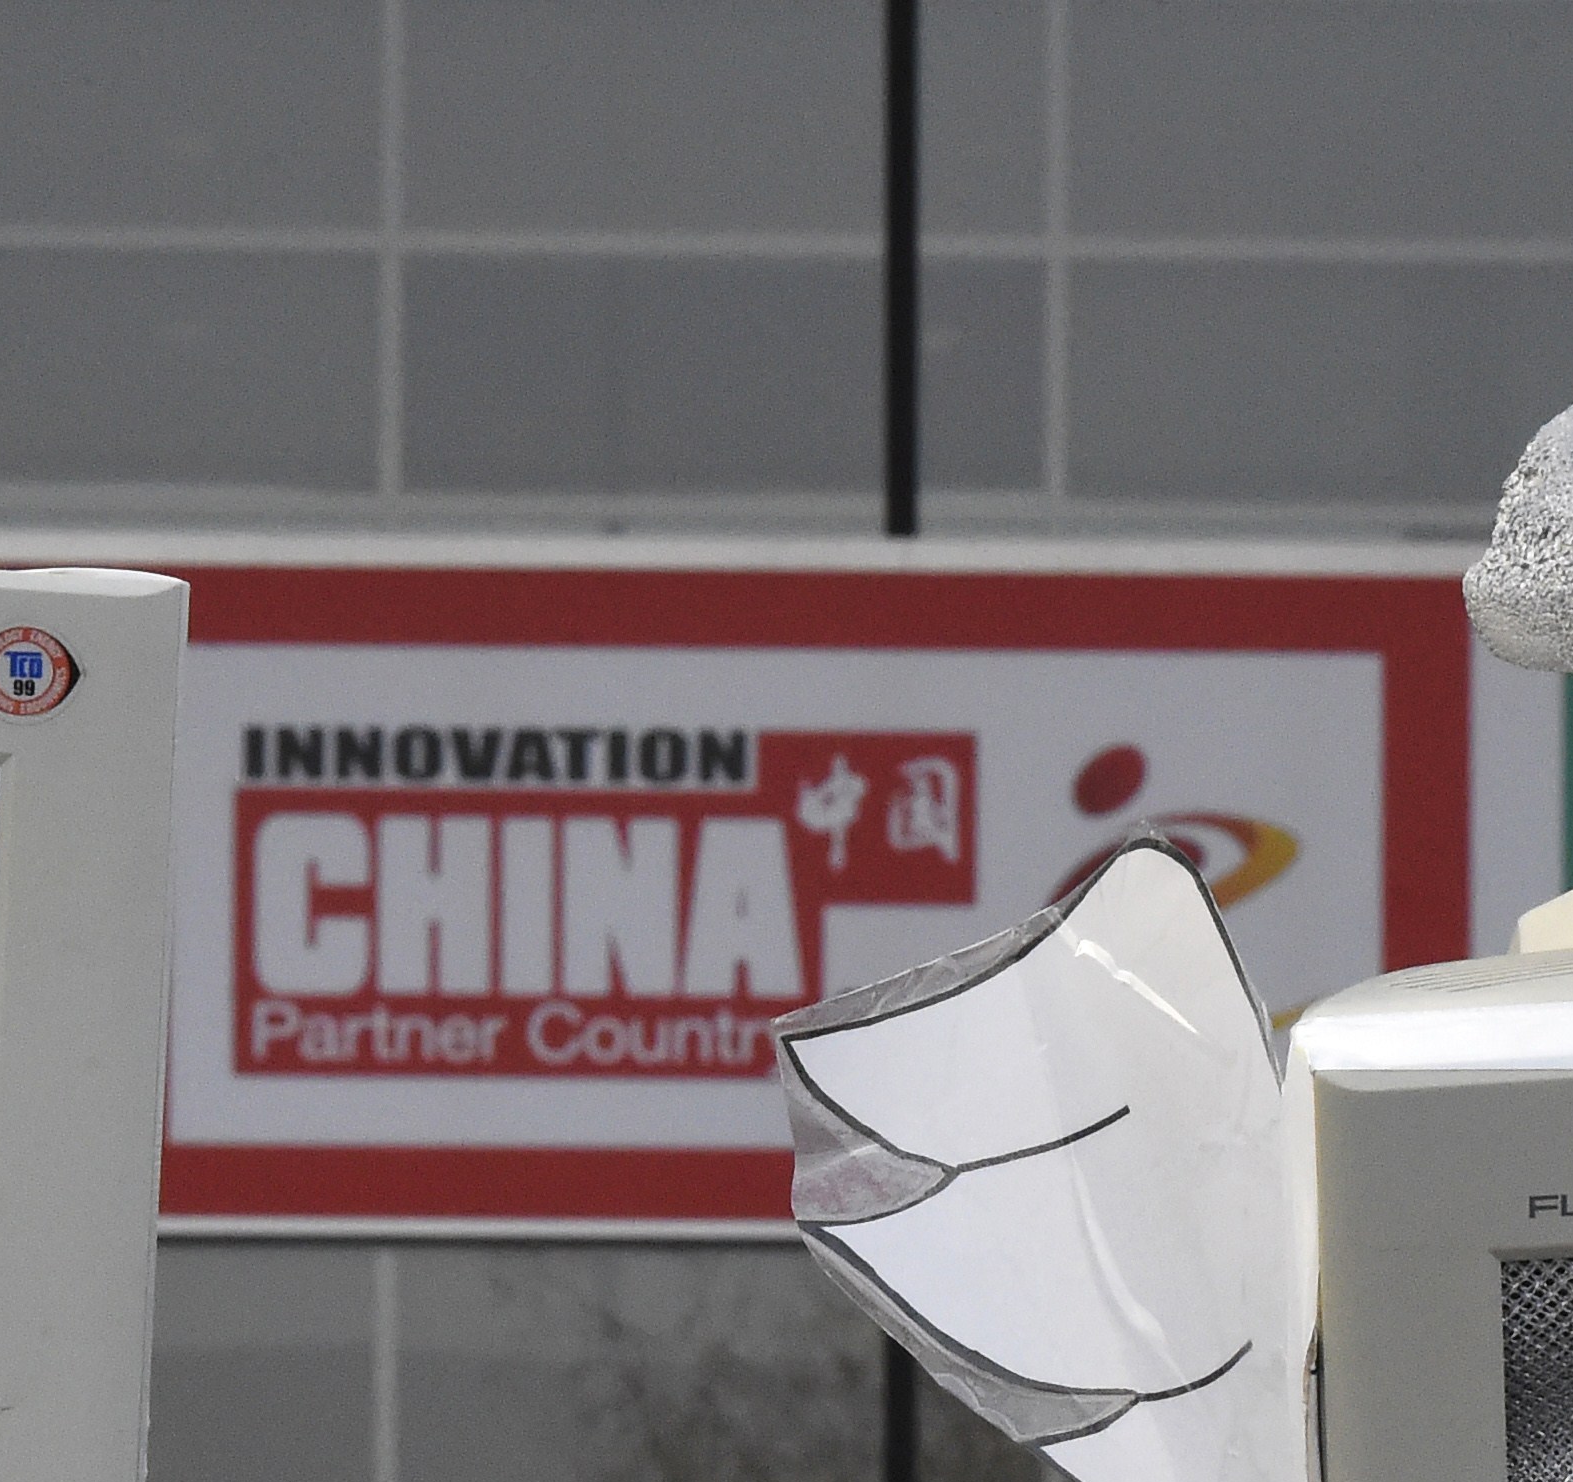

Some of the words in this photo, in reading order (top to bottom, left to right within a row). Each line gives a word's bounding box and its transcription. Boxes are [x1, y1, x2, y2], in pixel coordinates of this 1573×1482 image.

[4, 651, 43, 679] TCO
[13, 680, 36, 696] 99
[242, 725, 752, 784] INNOVATION
[253, 811, 806, 997] CHINA
[251, 1001, 503, 1064] Partner
